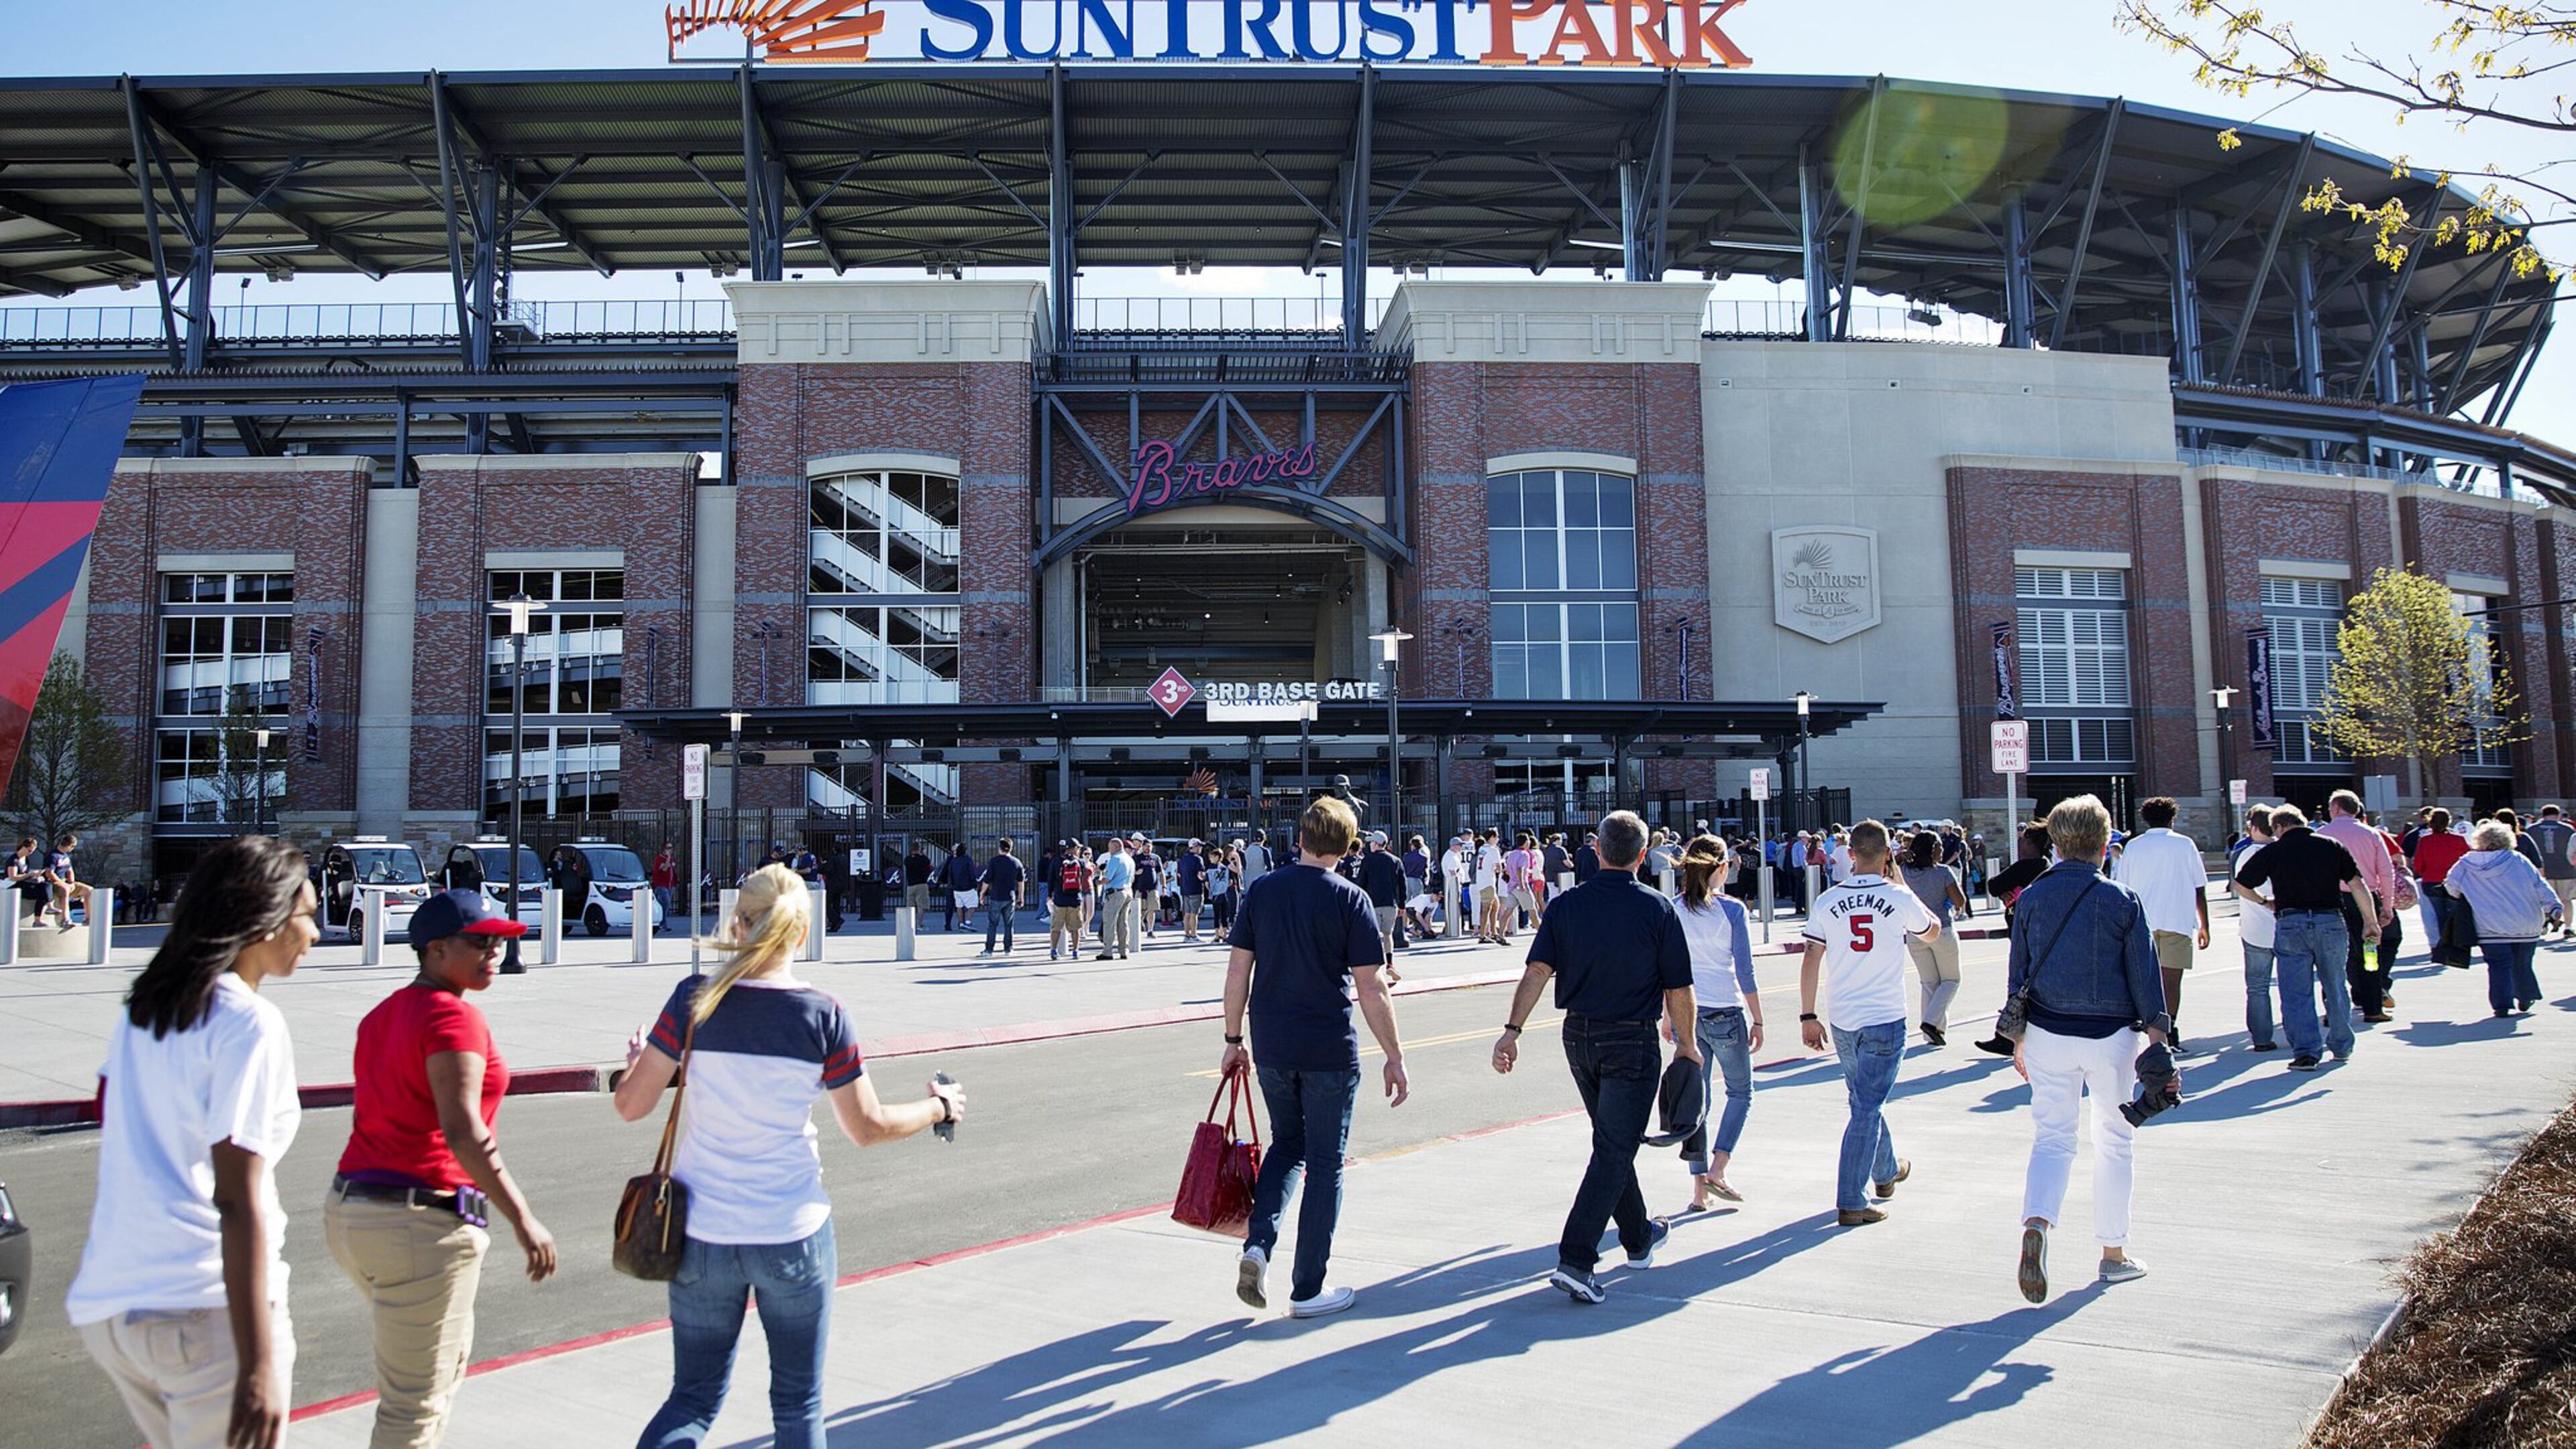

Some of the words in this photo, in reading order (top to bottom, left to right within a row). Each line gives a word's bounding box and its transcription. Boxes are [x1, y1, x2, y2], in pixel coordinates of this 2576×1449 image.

[1480, 0, 1754, 68] PARK
[1128, 439, 1316, 515] Braves
[1807, 588, 1849, 604] PARK
[1204, 683, 1249, 700] 3RD
[1258, 683, 1317, 700] BASE
[1325, 682, 1381, 699] GATE
[2002, 728, 2015, 737] NO
[1994, 739, 2023, 749] PARKING
[690, 752, 698, 761] NO
[1829, 894, 1895, 918] FREEMAN
[1849, 914, 1874, 953] 5
